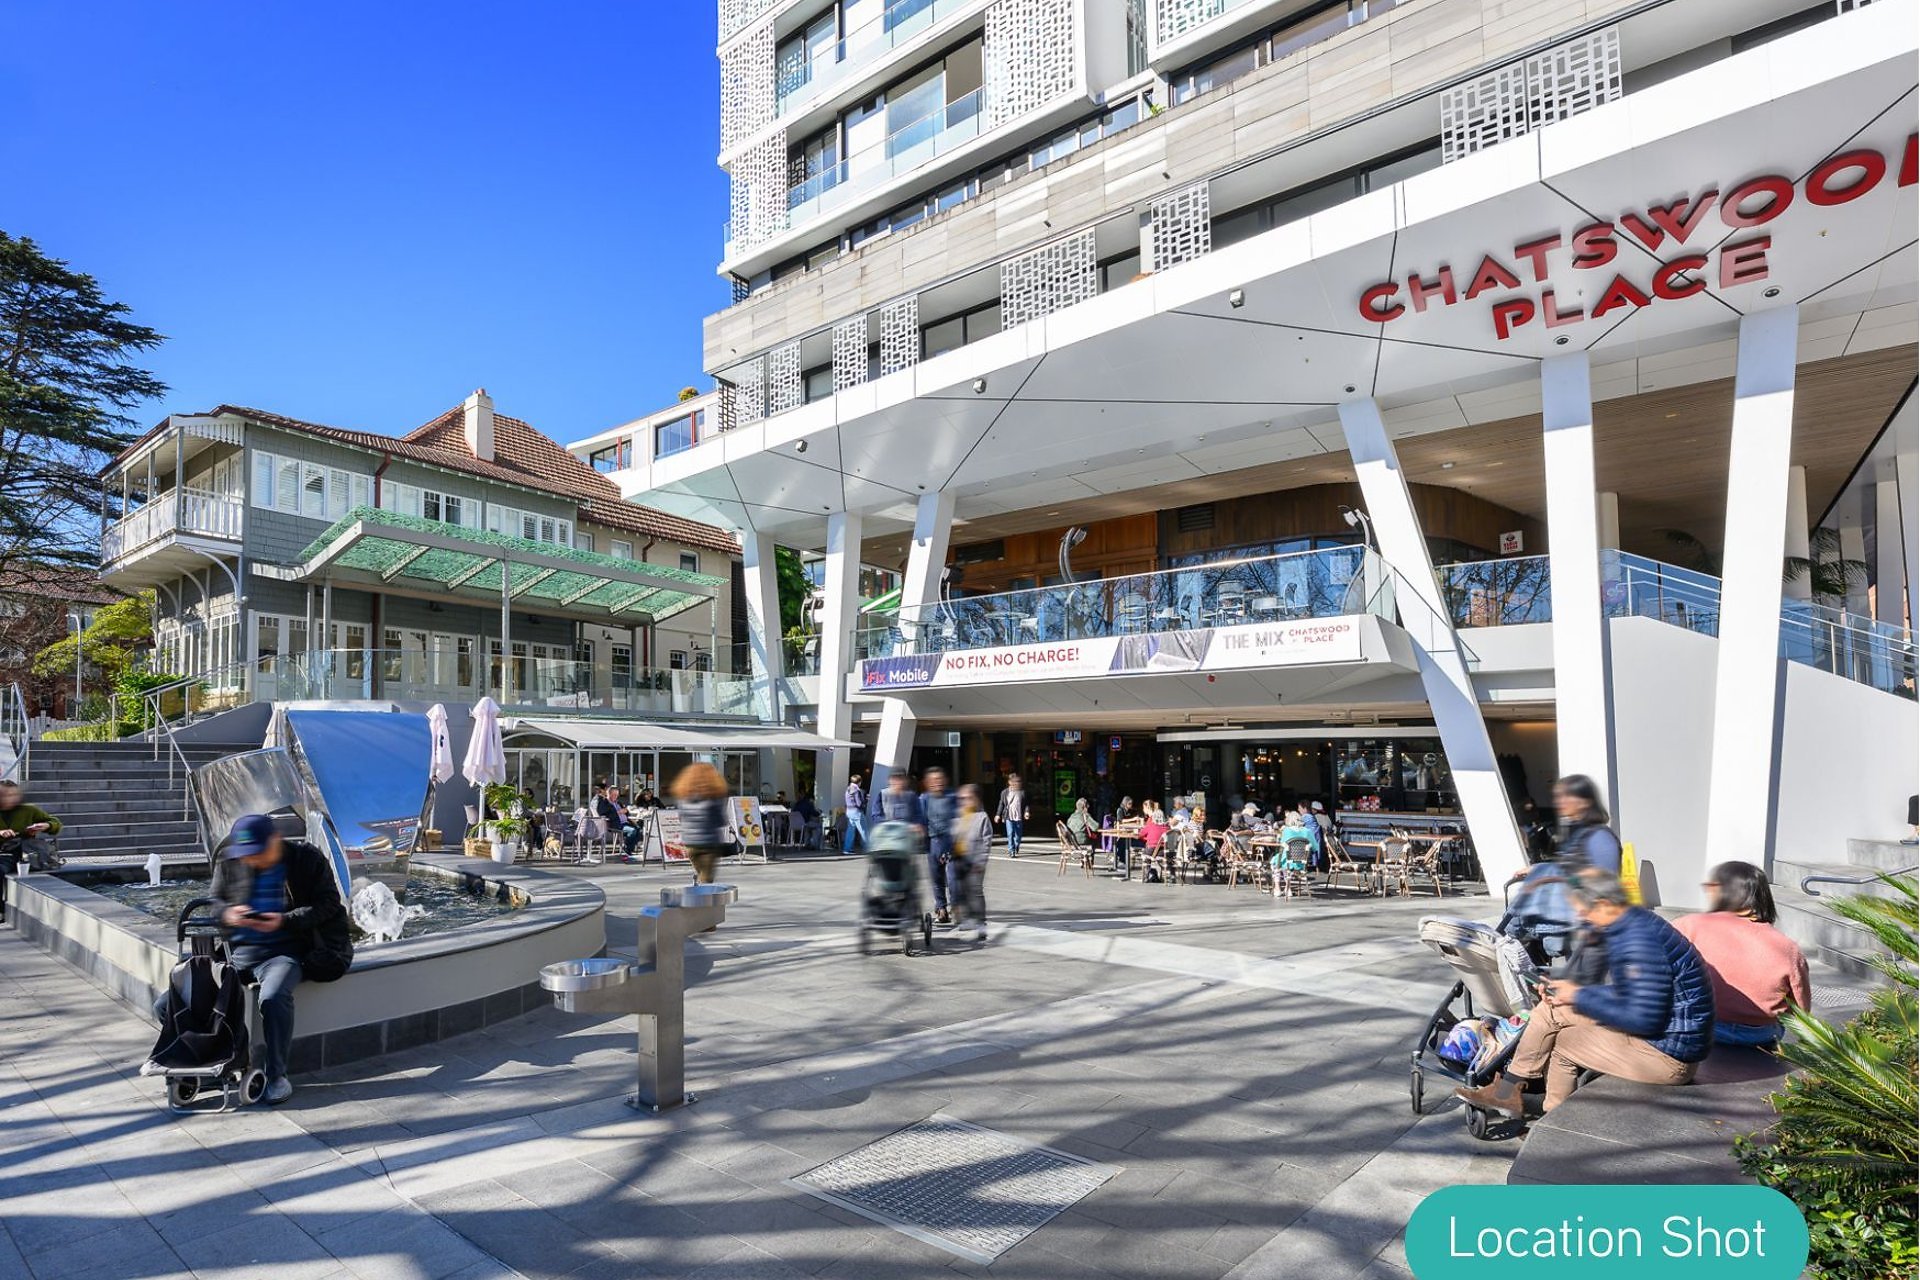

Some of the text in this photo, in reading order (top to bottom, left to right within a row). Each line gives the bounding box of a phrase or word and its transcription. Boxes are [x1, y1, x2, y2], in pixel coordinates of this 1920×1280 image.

[1359, 133, 1920, 322] CHATSWOO
[1491, 235, 1771, 340] PLACE
[1222, 630, 1285, 650] THE MIX
[1288, 625, 1351, 637] CHATSWOOD
[1303, 634, 1334, 643] PLACE
[946, 648, 1080, 670] NO FIX, NO CHARGE!
[889, 667, 929, 684] Mobile
